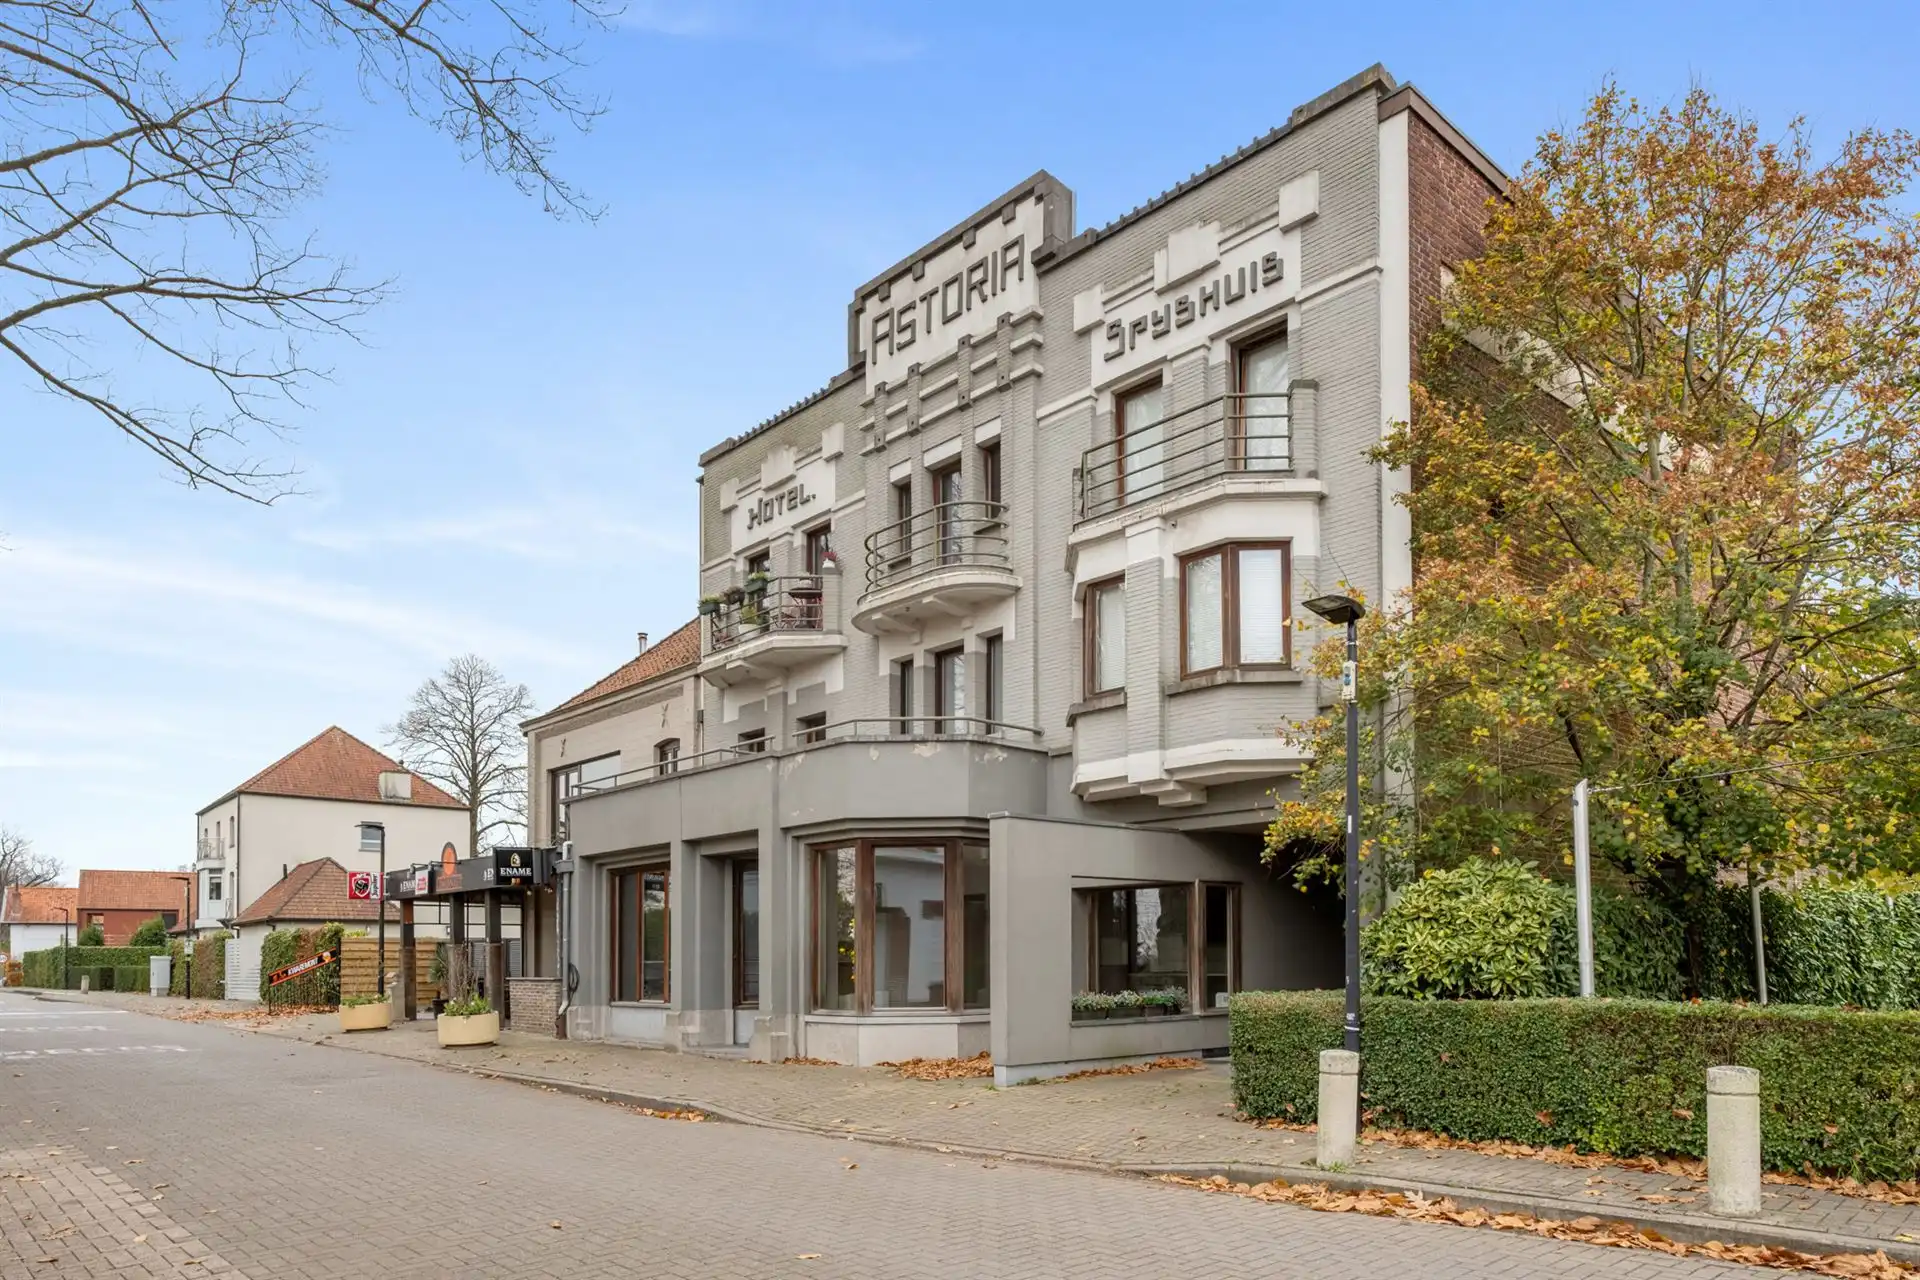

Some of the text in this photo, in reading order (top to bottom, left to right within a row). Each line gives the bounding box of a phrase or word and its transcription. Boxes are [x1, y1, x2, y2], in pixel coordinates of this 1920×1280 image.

[872, 234, 1025, 365] ASTORIA
[1104, 251, 1284, 362] SPYSHUIS
[500, 867, 532, 876] ENAME
